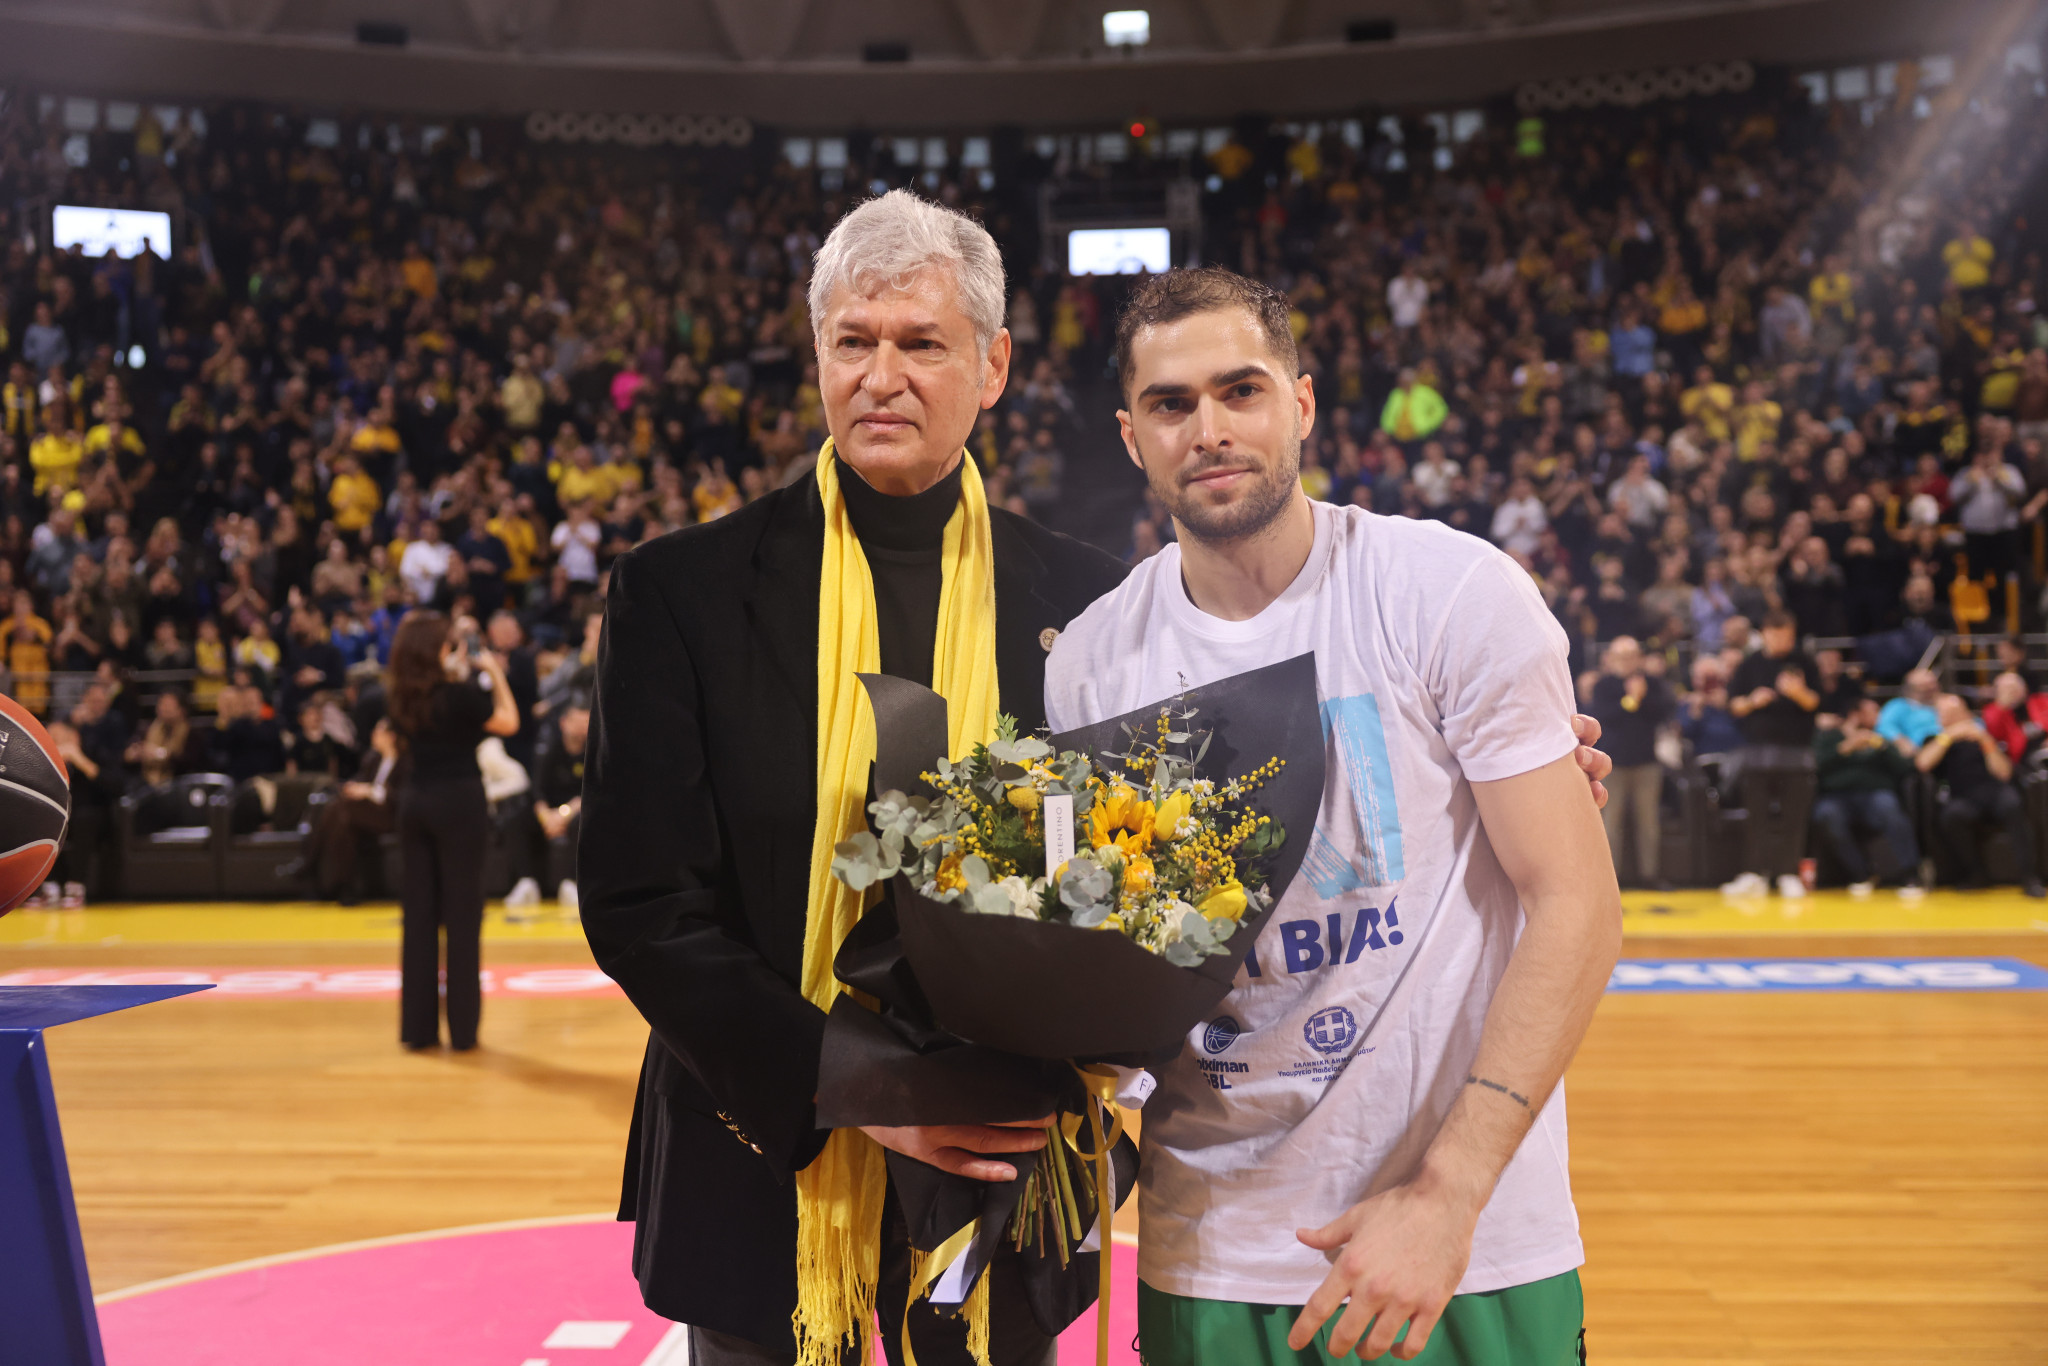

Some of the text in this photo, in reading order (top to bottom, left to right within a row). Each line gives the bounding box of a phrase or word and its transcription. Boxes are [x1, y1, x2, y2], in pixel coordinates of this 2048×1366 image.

[1056, 806, 1065, 863] ORENTINO
[1293, 1055, 1353, 1069] ΕΛΛΗΝΙΚΗ ΔΗΜΟ
[1277, 1068, 1312, 1078] Υπουργείο
